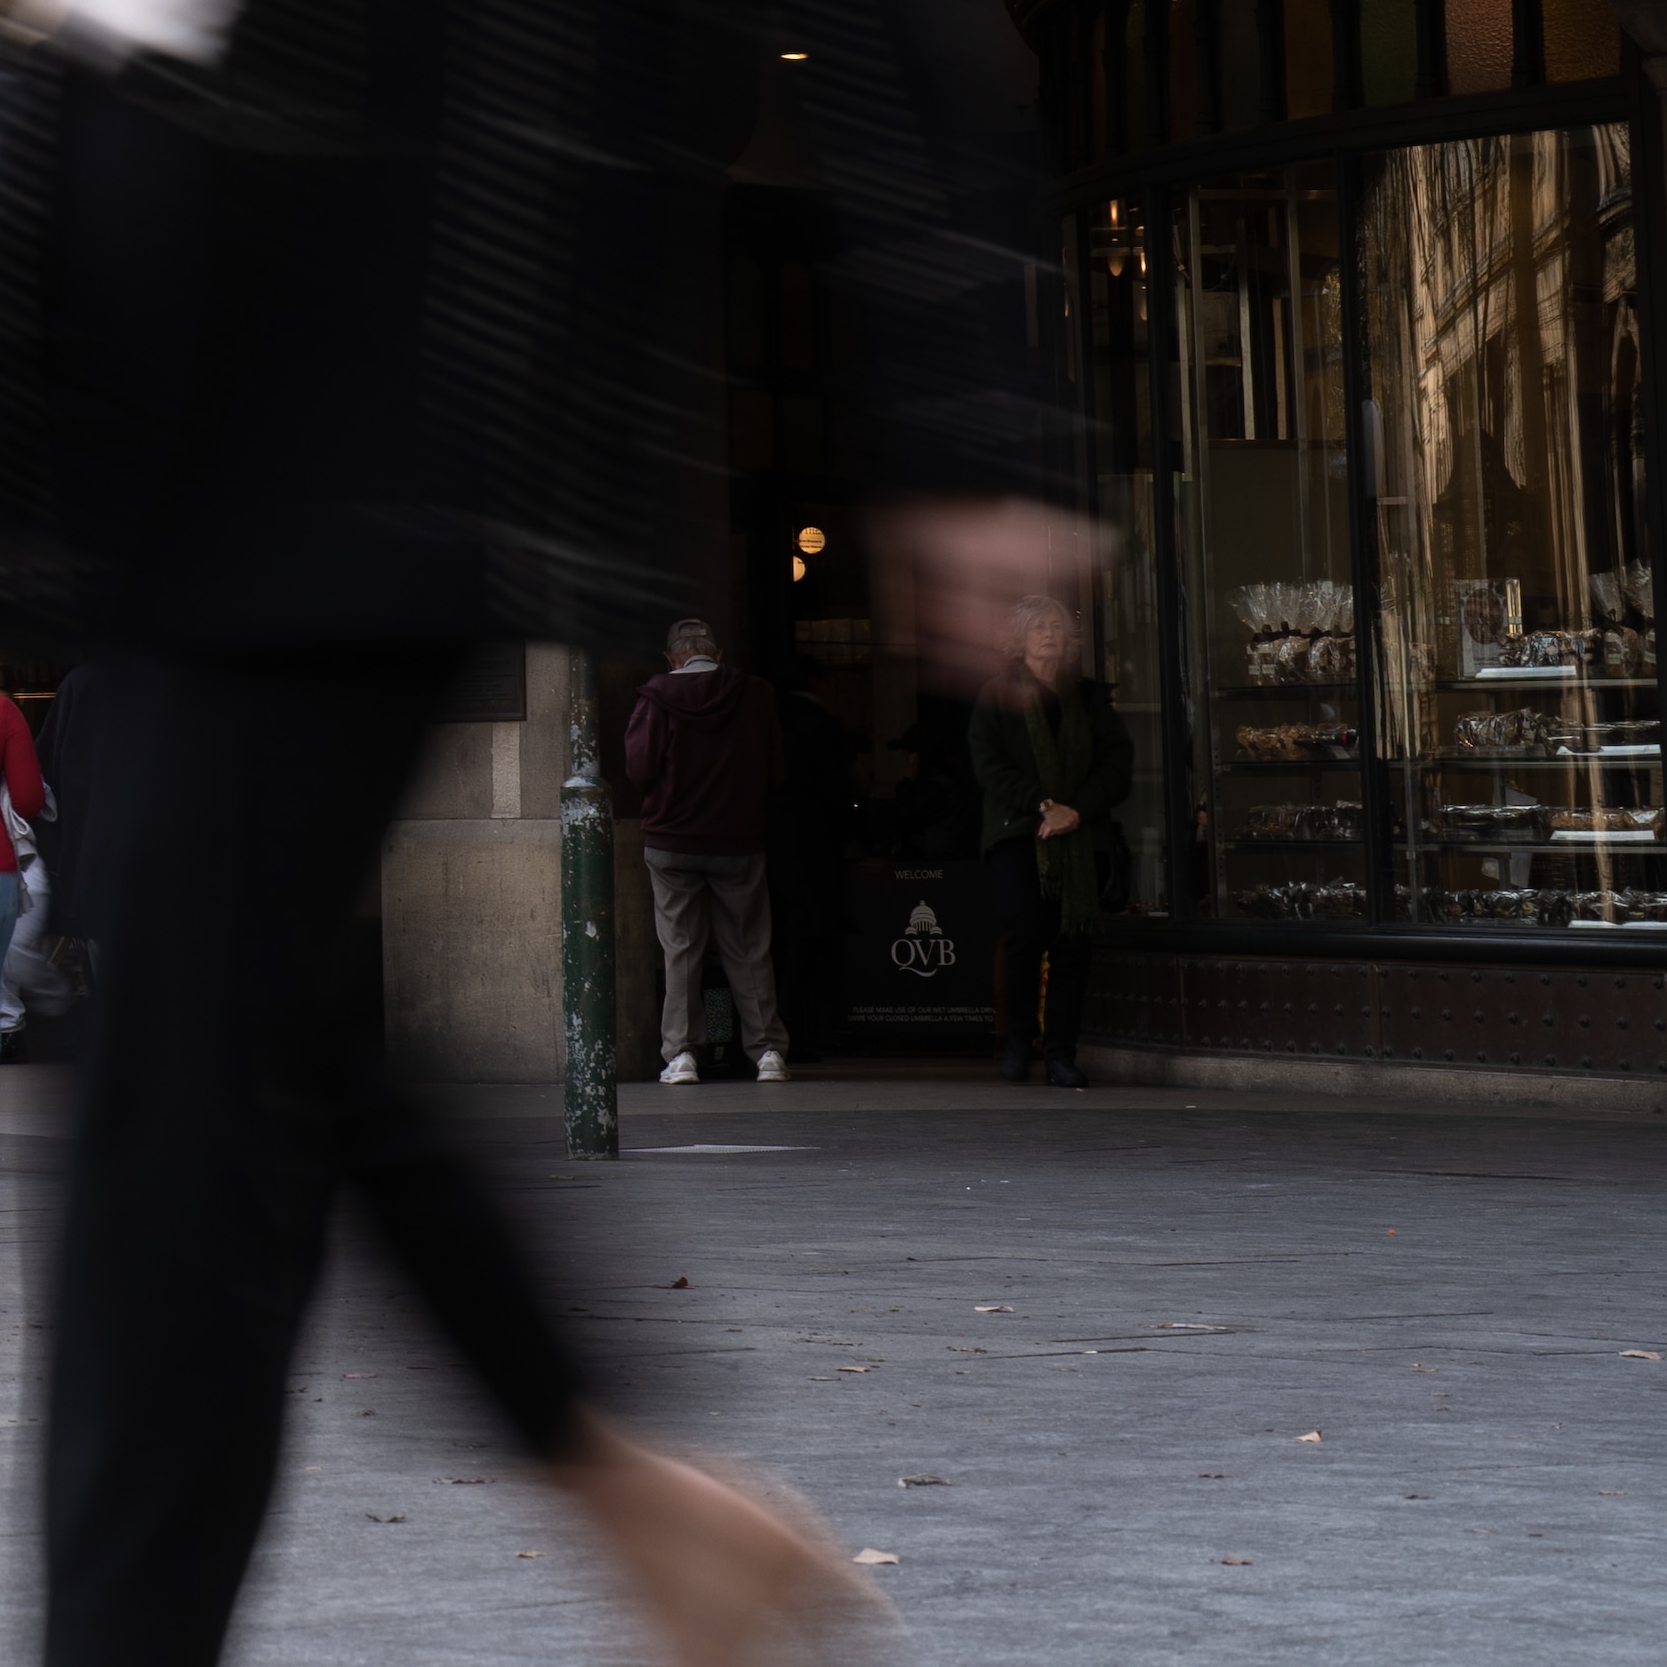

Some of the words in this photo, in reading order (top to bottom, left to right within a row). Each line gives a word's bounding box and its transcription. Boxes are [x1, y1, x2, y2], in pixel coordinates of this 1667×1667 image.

[895, 869, 943, 879] WELCOME
[891, 939, 956, 977] QVB
[852, 1006, 874, 1014] PLEASE
[875, 1006, 893, 1014] MAKE
[894, 1006, 906, 1014] USE
[907, 1006, 916, 1014] OF
[917, 1006, 932, 1014] OUR
[947, 1006, 979, 1014] UMBRELLA
